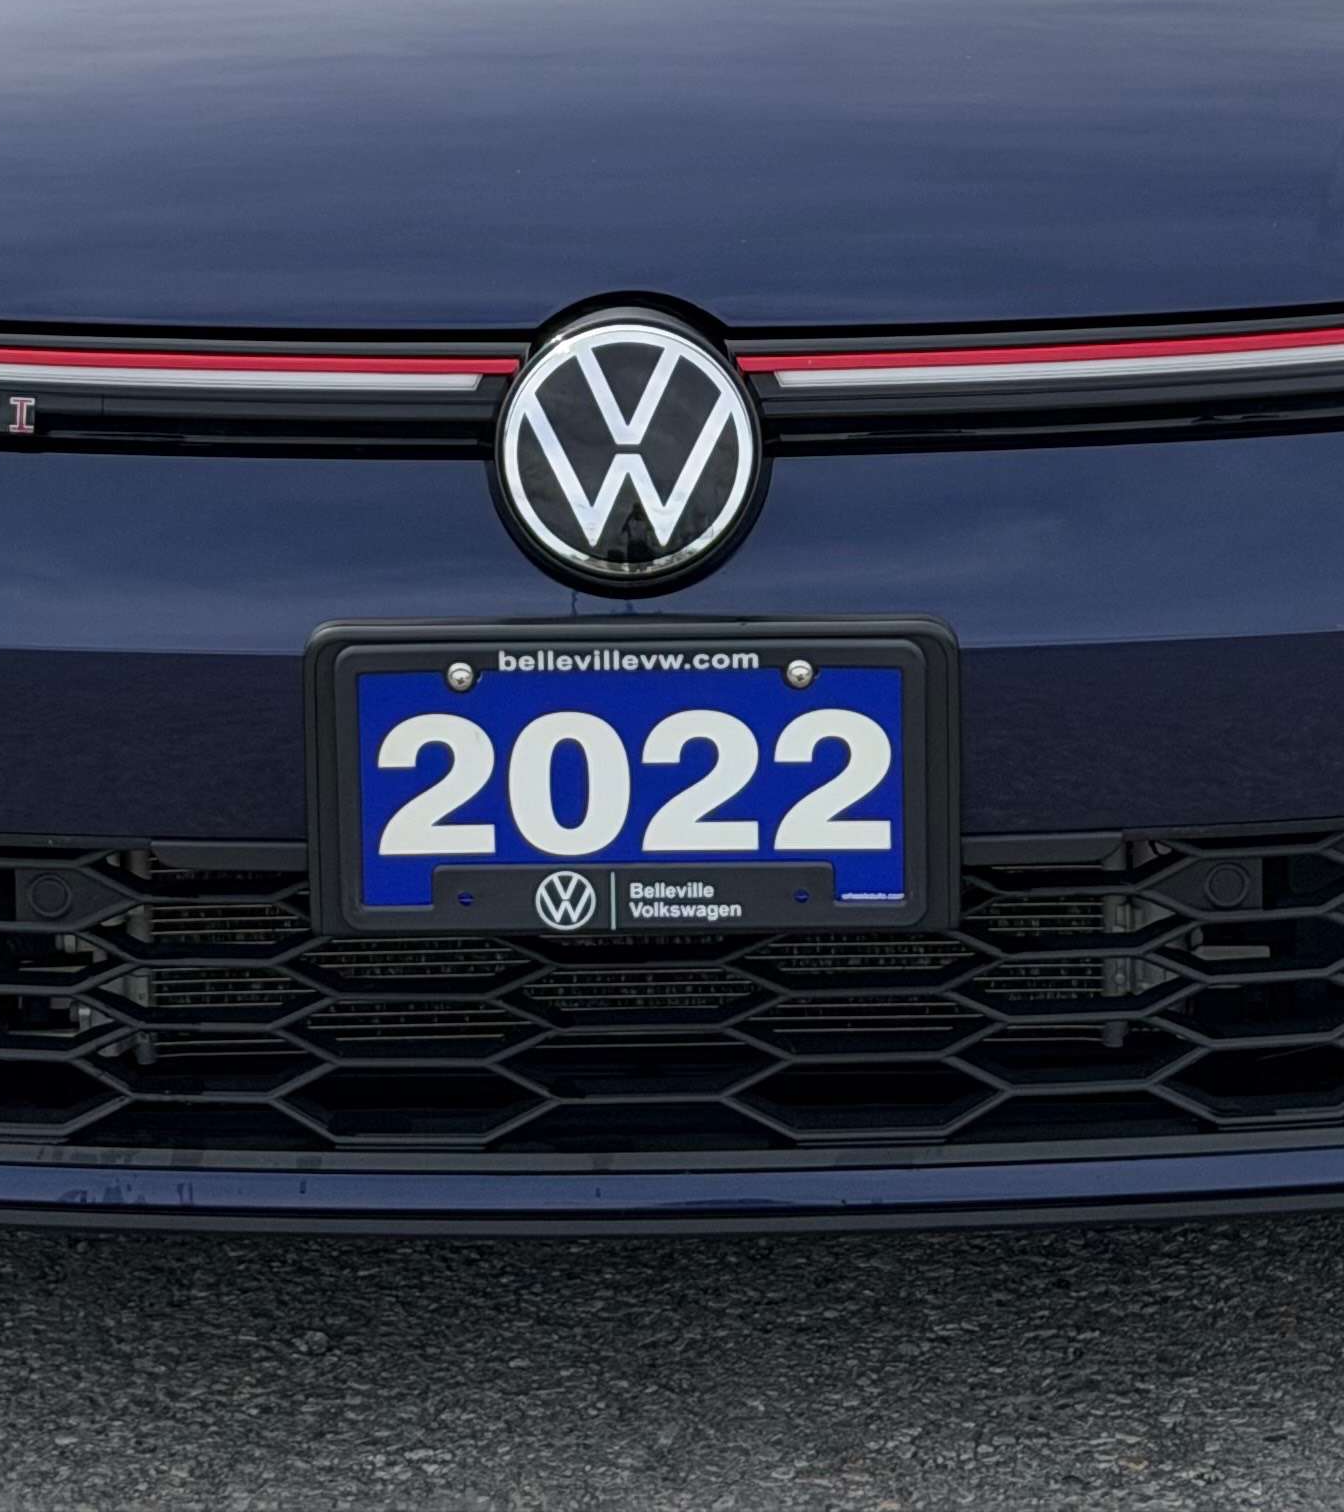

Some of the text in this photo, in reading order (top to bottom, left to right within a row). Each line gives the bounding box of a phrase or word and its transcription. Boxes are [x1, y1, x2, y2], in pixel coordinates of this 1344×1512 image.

[498, 649, 760, 671] bellevillevw.com
[377, 709, 892, 856] 2022
[629, 882, 715, 900] Belleville
[629, 901, 743, 921] Volkswagen
